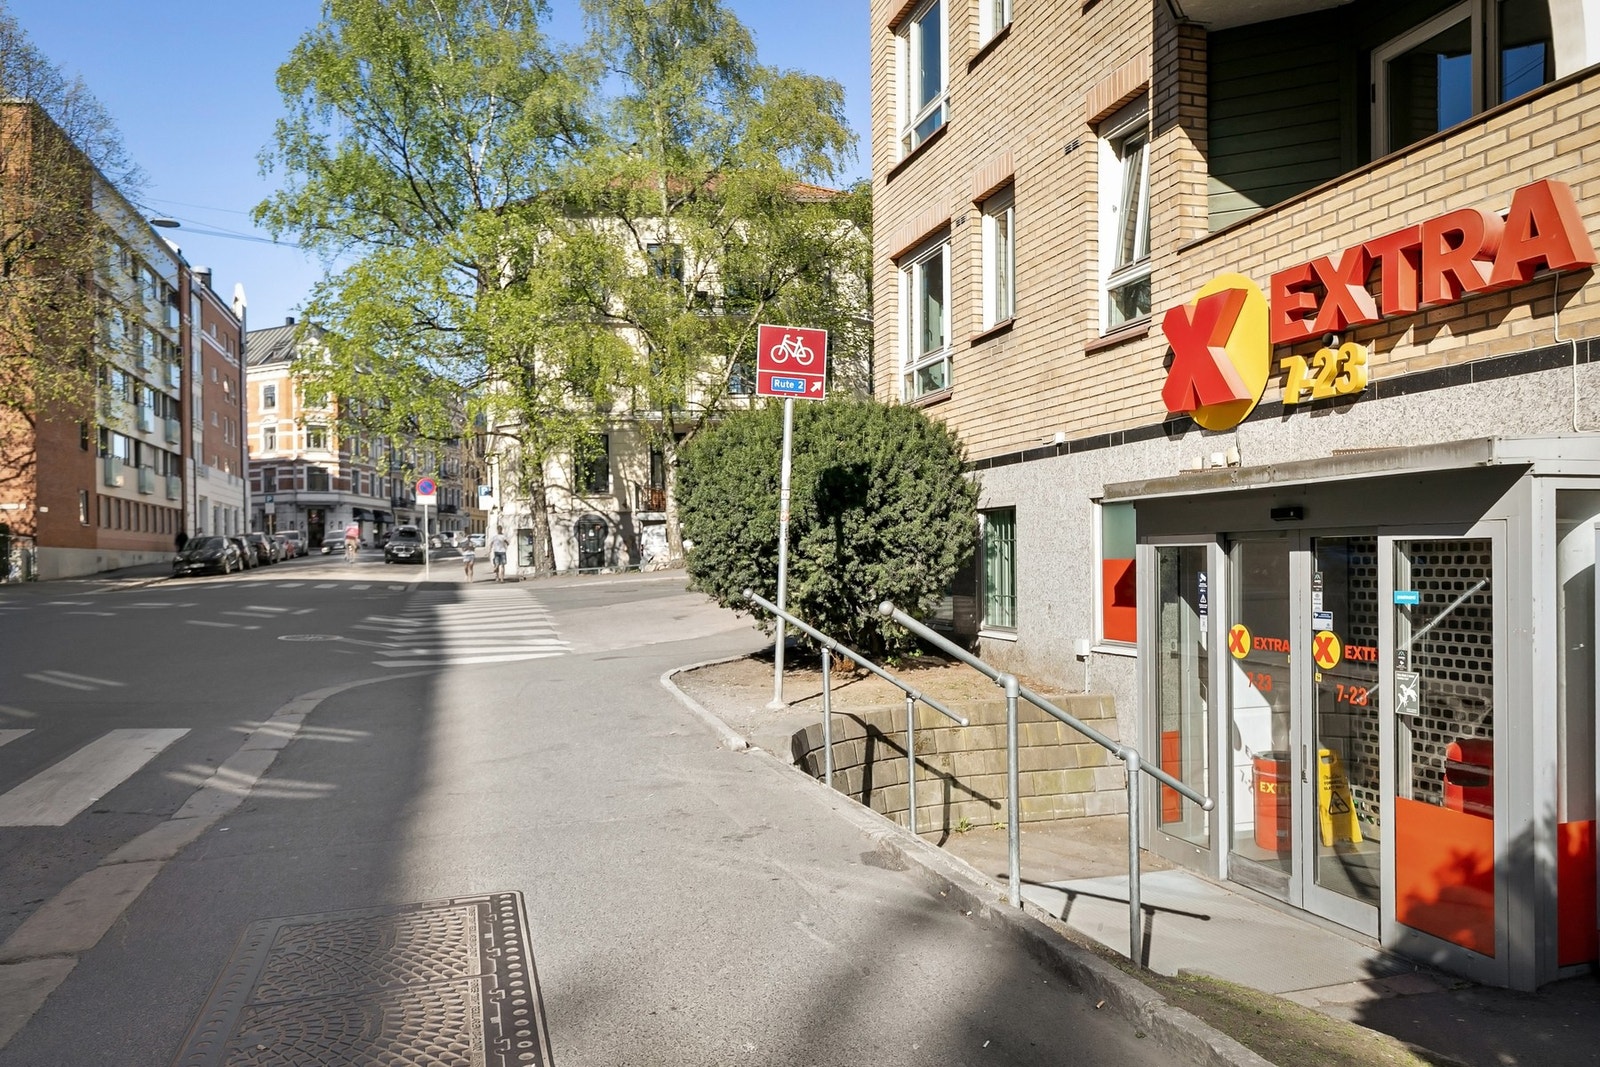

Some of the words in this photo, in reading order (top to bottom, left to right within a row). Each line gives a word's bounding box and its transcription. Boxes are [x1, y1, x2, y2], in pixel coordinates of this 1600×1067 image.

[1161, 288, 1252, 413] X
[1270, 179, 1598, 344] EXTRA
[775, 379, 795, 389] Rute
[798, 381, 803, 389] 2
[1281, 341, 1368, 405] 7-23
[481, 486, 488, 496] P
[1229, 629, 1246, 654] X
[1253, 637, 1290, 652] EXTRA
[1314, 636, 1335, 664] X
[1247, 671, 1272, 692] 7-23
[1336, 684, 1368, 706] 7-23
